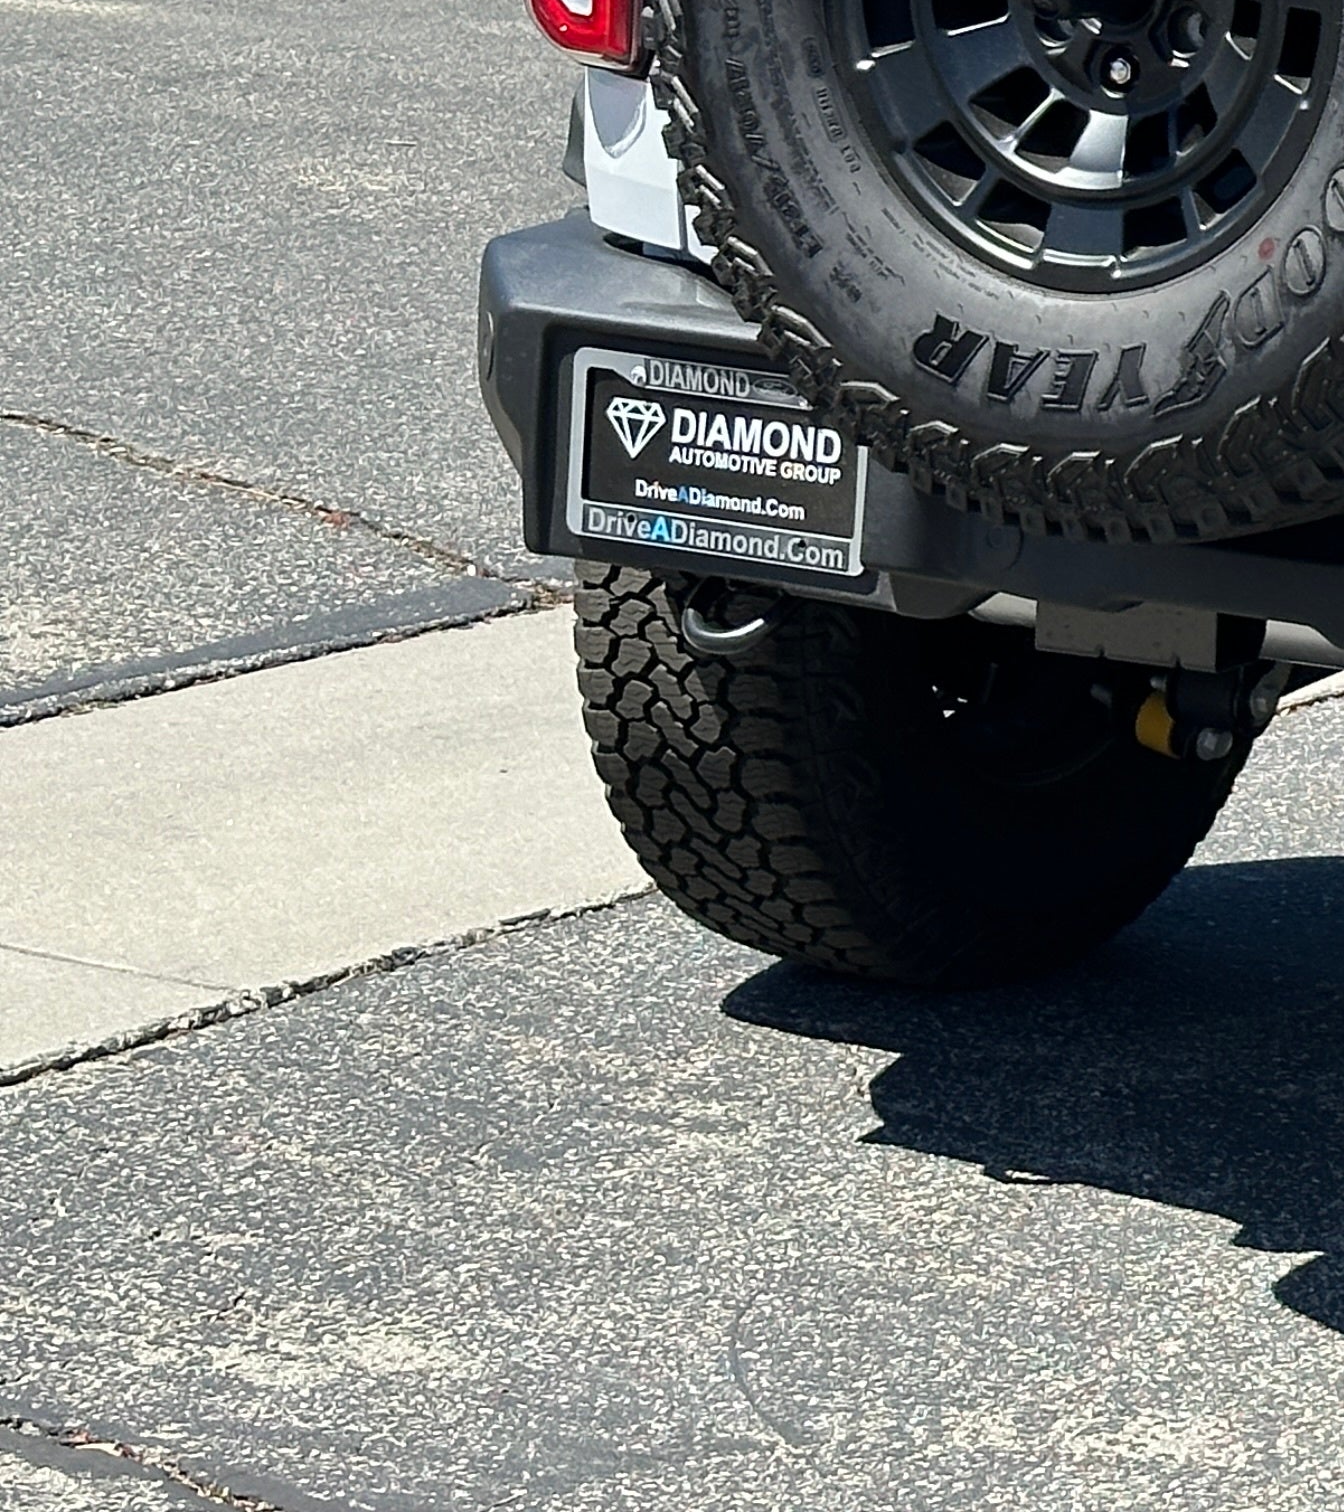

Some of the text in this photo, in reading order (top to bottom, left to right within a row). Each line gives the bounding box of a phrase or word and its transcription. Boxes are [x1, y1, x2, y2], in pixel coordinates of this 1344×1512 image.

[648, 359, 751, 398] DIAMOND
[671, 407, 843, 465] DIAMOND
[668, 446, 842, 485] AUTOMOTIVE GROUP
[635, 478, 806, 520] DriveADiamond.Com
[587, 507, 845, 570] DriveADiamond.Com
